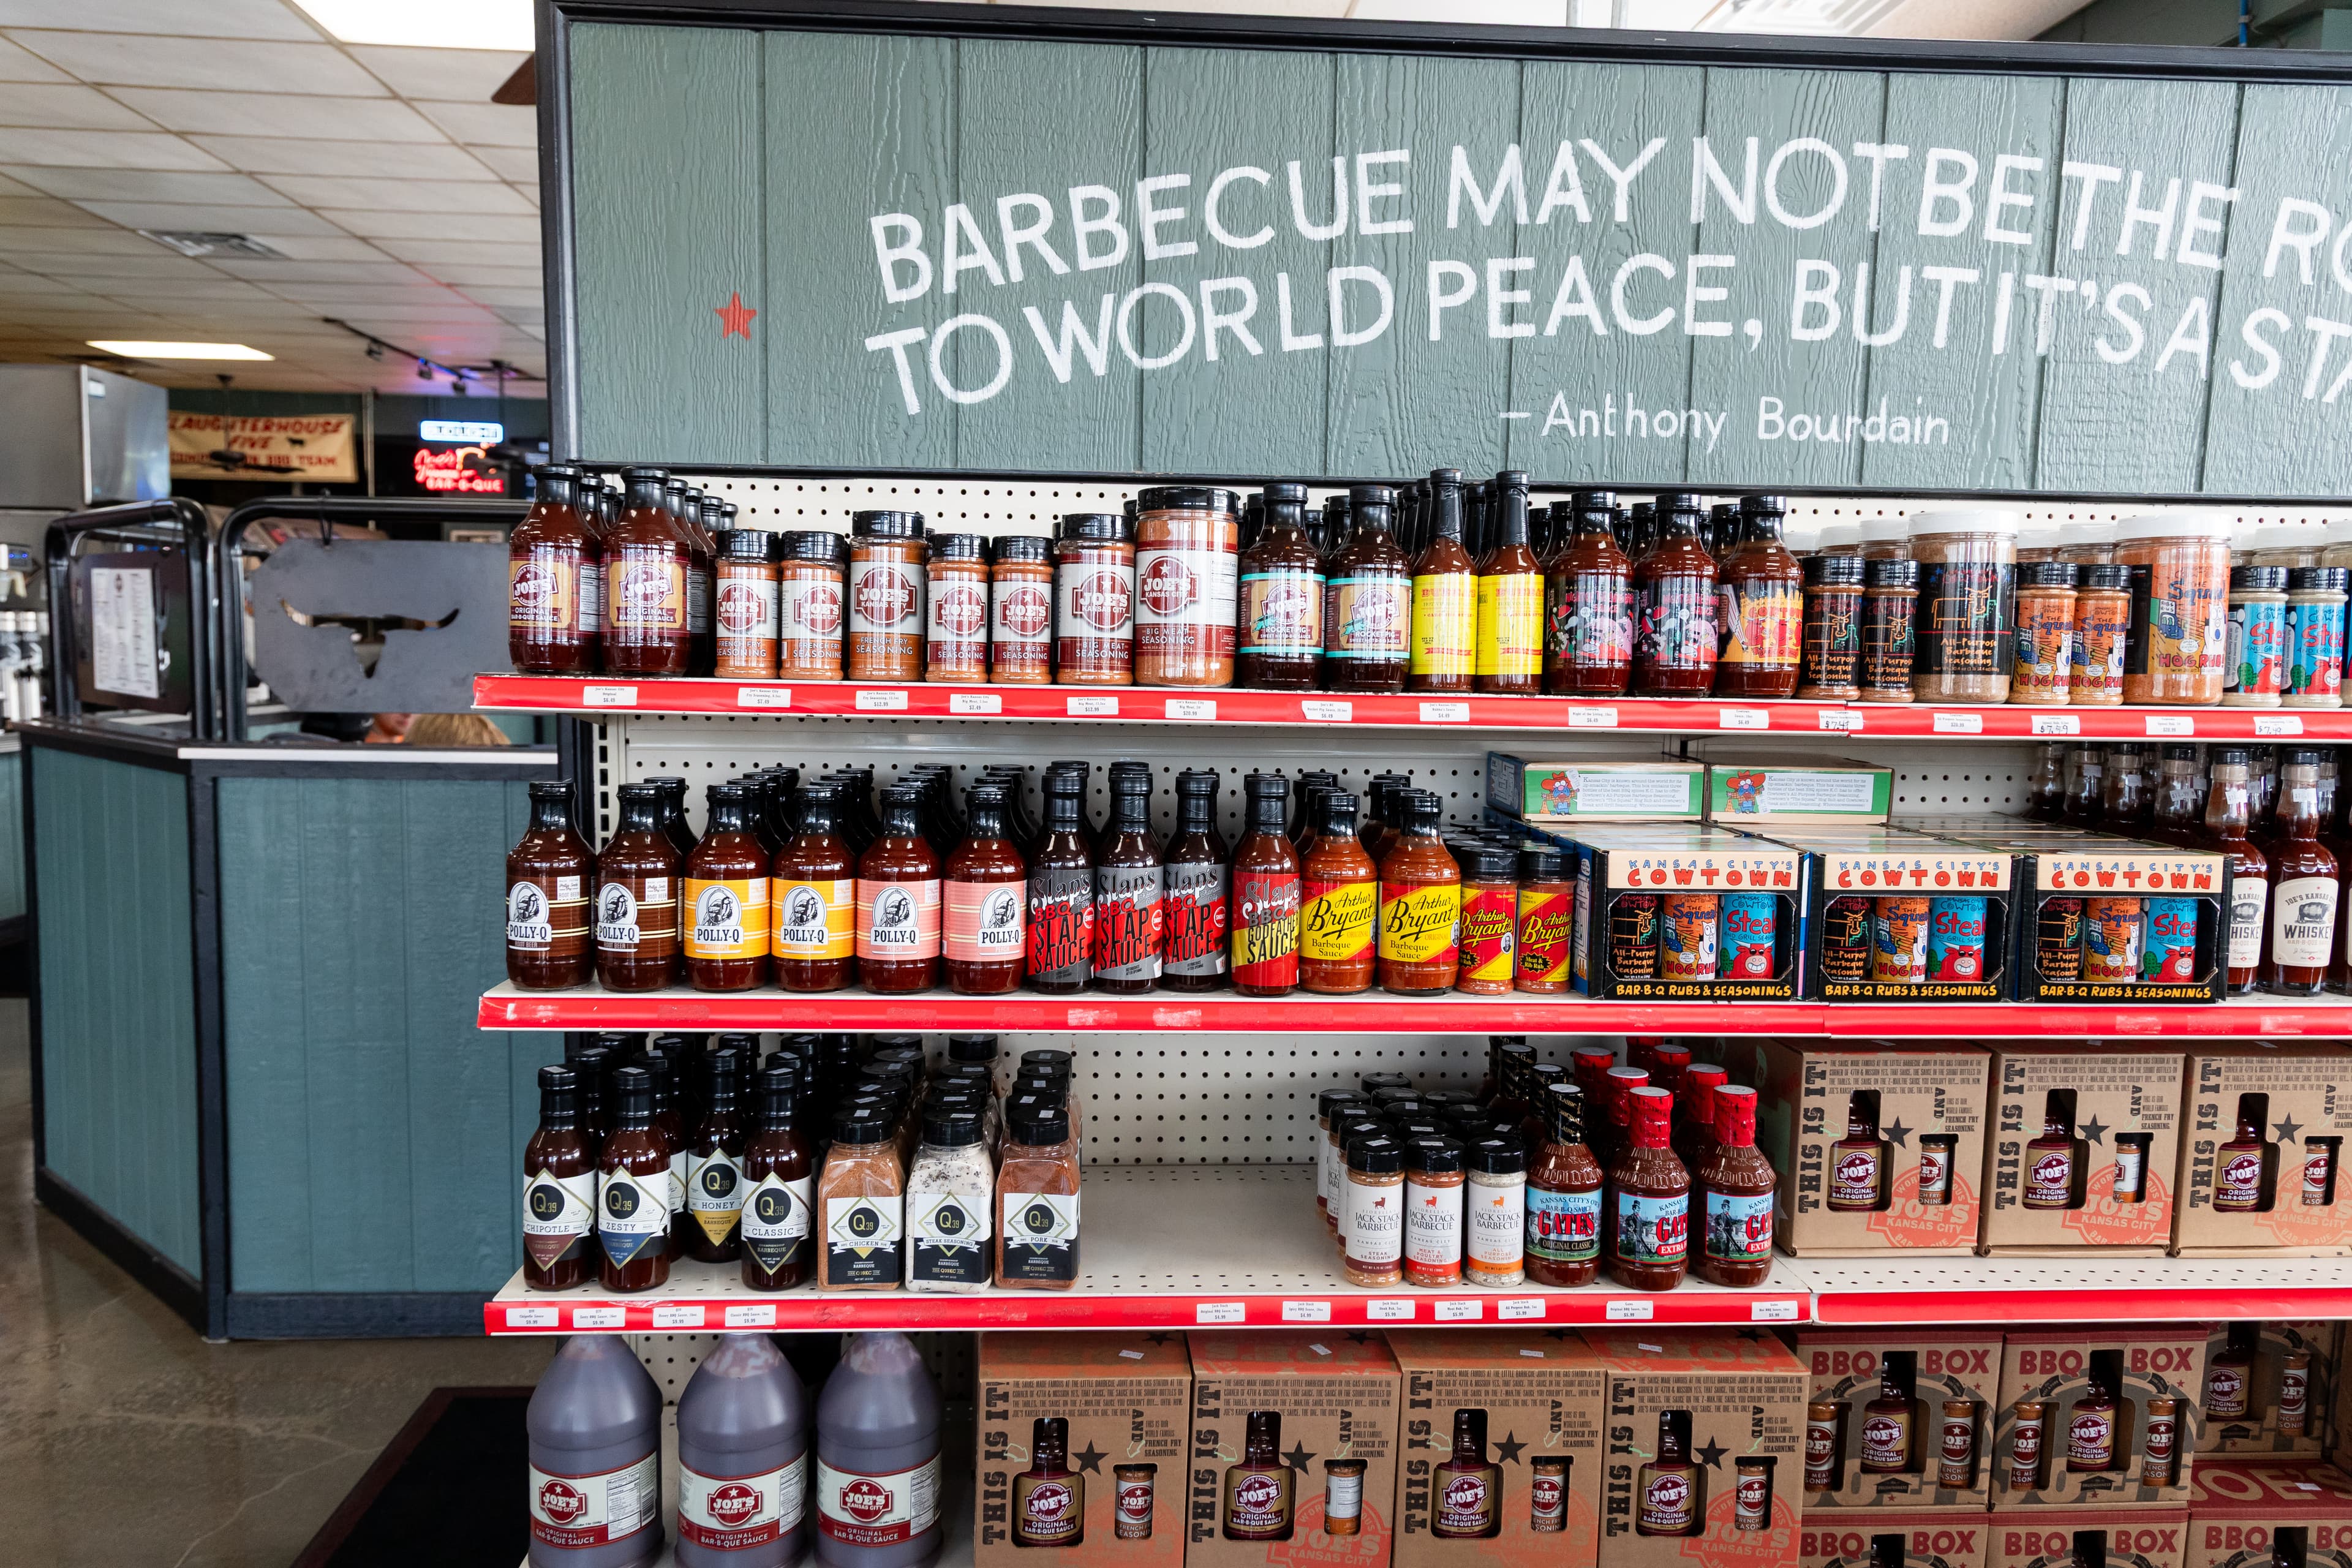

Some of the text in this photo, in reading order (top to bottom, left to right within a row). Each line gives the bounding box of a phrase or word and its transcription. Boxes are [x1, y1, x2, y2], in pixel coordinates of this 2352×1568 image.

[870, 137, 2352, 304] BARBECUE MAY NOT BE THE R
[865, 314, 1012, 415] TO
[1022, 266, 1395, 383] WORLD
[1428, 252, 1763, 353] PEACE,
[1791, 259, 1980, 349] BUT
[2154, 296, 2207, 381] A
[1541, 390, 1949, 453] Anthony Bourdain
[1144, 578, 1191, 591] JOE'S
[1080, 592, 1128, 607] JOE'S
[1076, 649, 1128, 659] SEASONING
[2159, 654, 2195, 667] HOG
[1629, 859, 1793, 870] KANSAS CITY'S
[1839, 860, 1999, 871] KANSAS CITY'S
[2053, 862, 2212, 873] KANSAS CITY'S
[1627, 869, 1792, 886] COWTOWN
[1838, 869, 1998, 888] COWTOWN
[2051, 870, 2211, 889] COWTOWN
[1335, 891, 1371, 908] Arthur
[1413, 893, 1451, 911] Arthur
[1101, 897, 1136, 918] BBQ
[1248, 906, 1286, 927] BBQ
[510, 924, 547, 940] POLLY-Q
[598, 925, 635, 942] POLLY-Q
[1101, 907, 1149, 946] SLAP
[1248, 912, 1298, 943] GODFATHER
[697, 929, 739, 943] POLLY-Q
[783, 929, 824, 944] POLLY-Q
[874, 930, 916, 944] POLLY-Q
[982, 930, 1019, 944] POLLY-Q
[1247, 931, 1295, 964] SAUCE
[1312, 938, 1351, 950] Barbeque
[1390, 940, 1428, 951] Barbeque
[1100, 933, 1152, 971] SAUCE
[1396, 951, 1420, 959] Sauce
[1666, 961, 1695, 974] HOG
[1669, 985, 1700, 996] RUBS
[1703, 986, 1712, 996] &
[1714, 986, 1792, 997] SEASONINGS
[1877, 985, 1908, 997] RUBS
[1910, 986, 1918, 996] &
[1921, 986, 1997, 997] SEASONINGS
[2092, 986, 2122, 997] RUBS
[2125, 986, 2133, 997] &
[2136, 987, 2211, 998] SEASONINGS
[1803, 1107, 1825, 1134] IS
[1798, 1144, 1823, 1213] THIS
[701, 1200, 735, 1209] HONEY
[1540, 1196, 1590, 1205] KANSAS CITY'S
[1409, 1211, 1455, 1223] JACK STACK
[1474, 1211, 1520, 1223] JACK STACK
[1885, 1197, 1970, 1224] JOE'S
[1355, 1212, 1400, 1224] JACK STACK
[1411, 1219, 1454, 1230] BARBECUE
[1476, 1218, 1520, 1230] BARBECUE
[1537, 1211, 1594, 1237] GATES
[526, 1224, 570, 1234] CHIPOTLE
[606, 1222, 636, 1231] ZESTY
[752, 1226, 794, 1237] CLASSIC
[1357, 1220, 1399, 1231] BARBECUE
[1887, 1218, 1962, 1234] KANSAS CITY
[943, 1238, 973, 1247] SEASONING
[1542, 1239, 1592, 1250] ORIGINAL CLASSIC
[1660, 1245, 1684, 1254] EXTRA
[1749, 1242, 1770, 1252] EXTRA
[1812, 1349, 1991, 1378] BBQ BOX
[2019, 1348, 2194, 1378] BBQ BOX
[1408, 1420, 1431, 1449] IS
[845, 1493, 886, 1506] JOE'S
[1404, 1460, 1430, 1534] THIS
[1448, 1487, 1485, 1503] JOE'S
[713, 1497, 755, 1509] JOE'S
[742, 1534, 768, 1546] SAUCE
[1800, 1531, 1976, 1559] BBQ BOX
